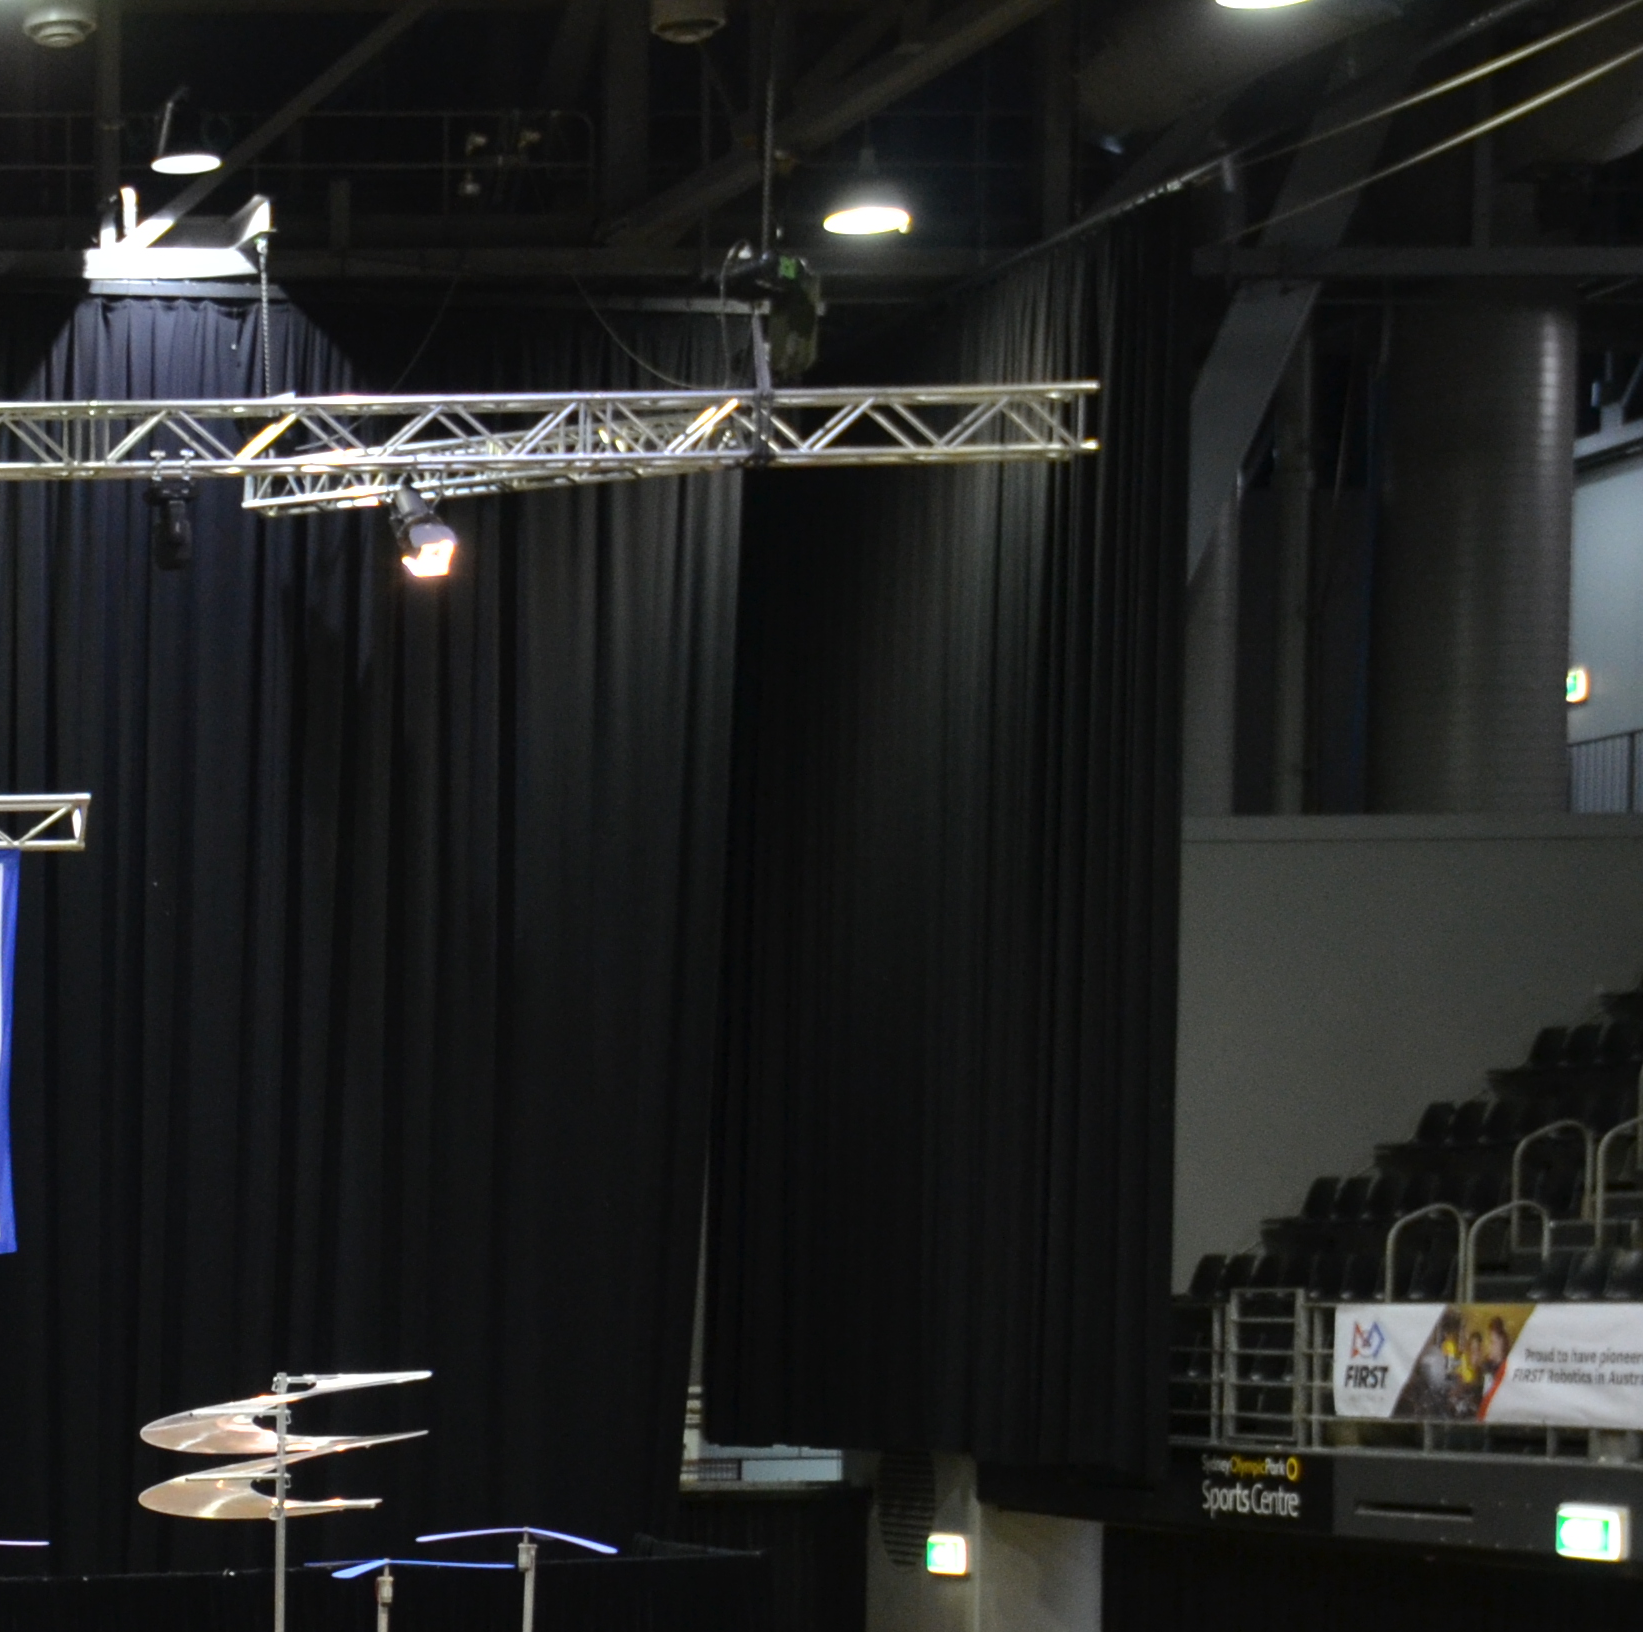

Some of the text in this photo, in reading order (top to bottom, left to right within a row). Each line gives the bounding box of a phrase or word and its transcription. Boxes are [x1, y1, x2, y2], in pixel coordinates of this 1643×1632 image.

[1571, 1350, 1597, 1363] have
[1344, 1364, 1389, 1389] FIRST
[1547, 1368, 1593, 1384] Robotics
[1608, 1370, 1643, 1386] Austr
[1201, 1479, 1300, 1519] Sports Centre
